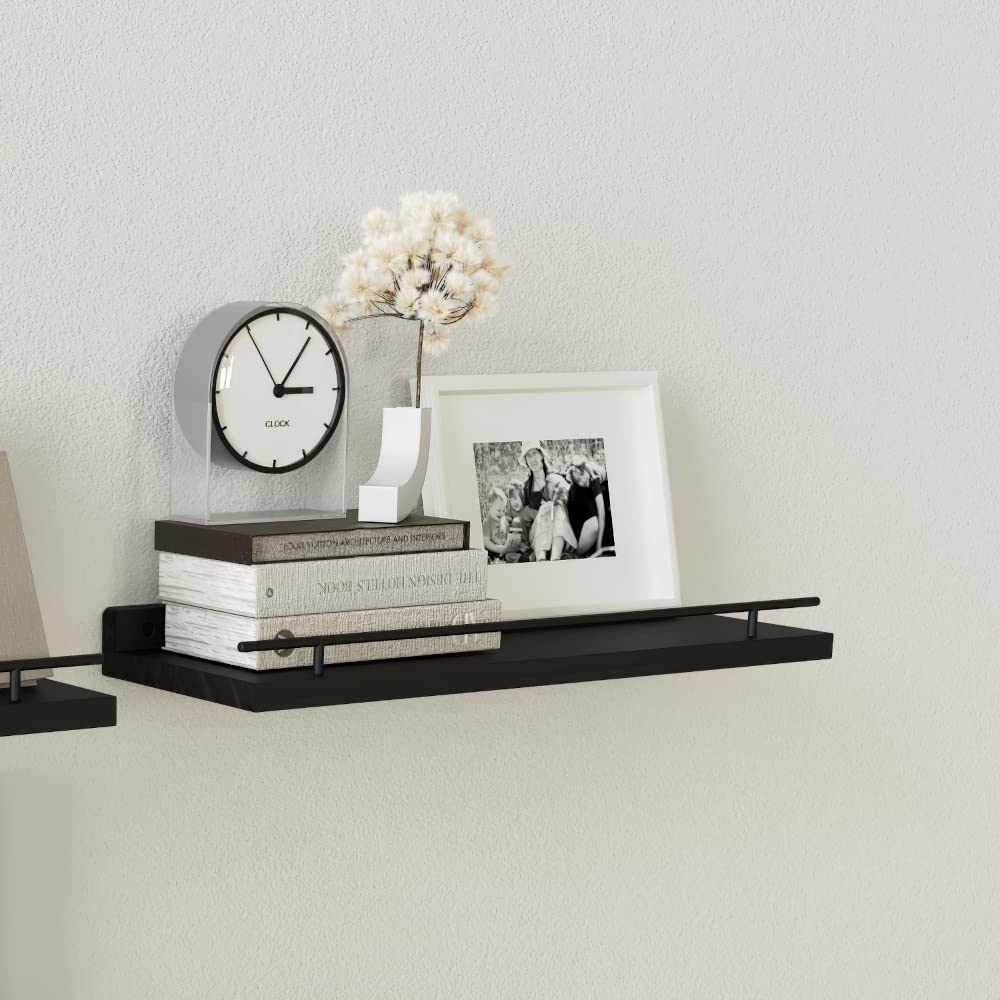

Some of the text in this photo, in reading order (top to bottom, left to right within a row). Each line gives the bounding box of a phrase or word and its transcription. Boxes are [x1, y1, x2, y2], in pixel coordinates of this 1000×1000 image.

[265, 419, 290, 428] CLOCK
[456, 570, 482, 586] THE
[316, 580, 352, 596] BOOK
